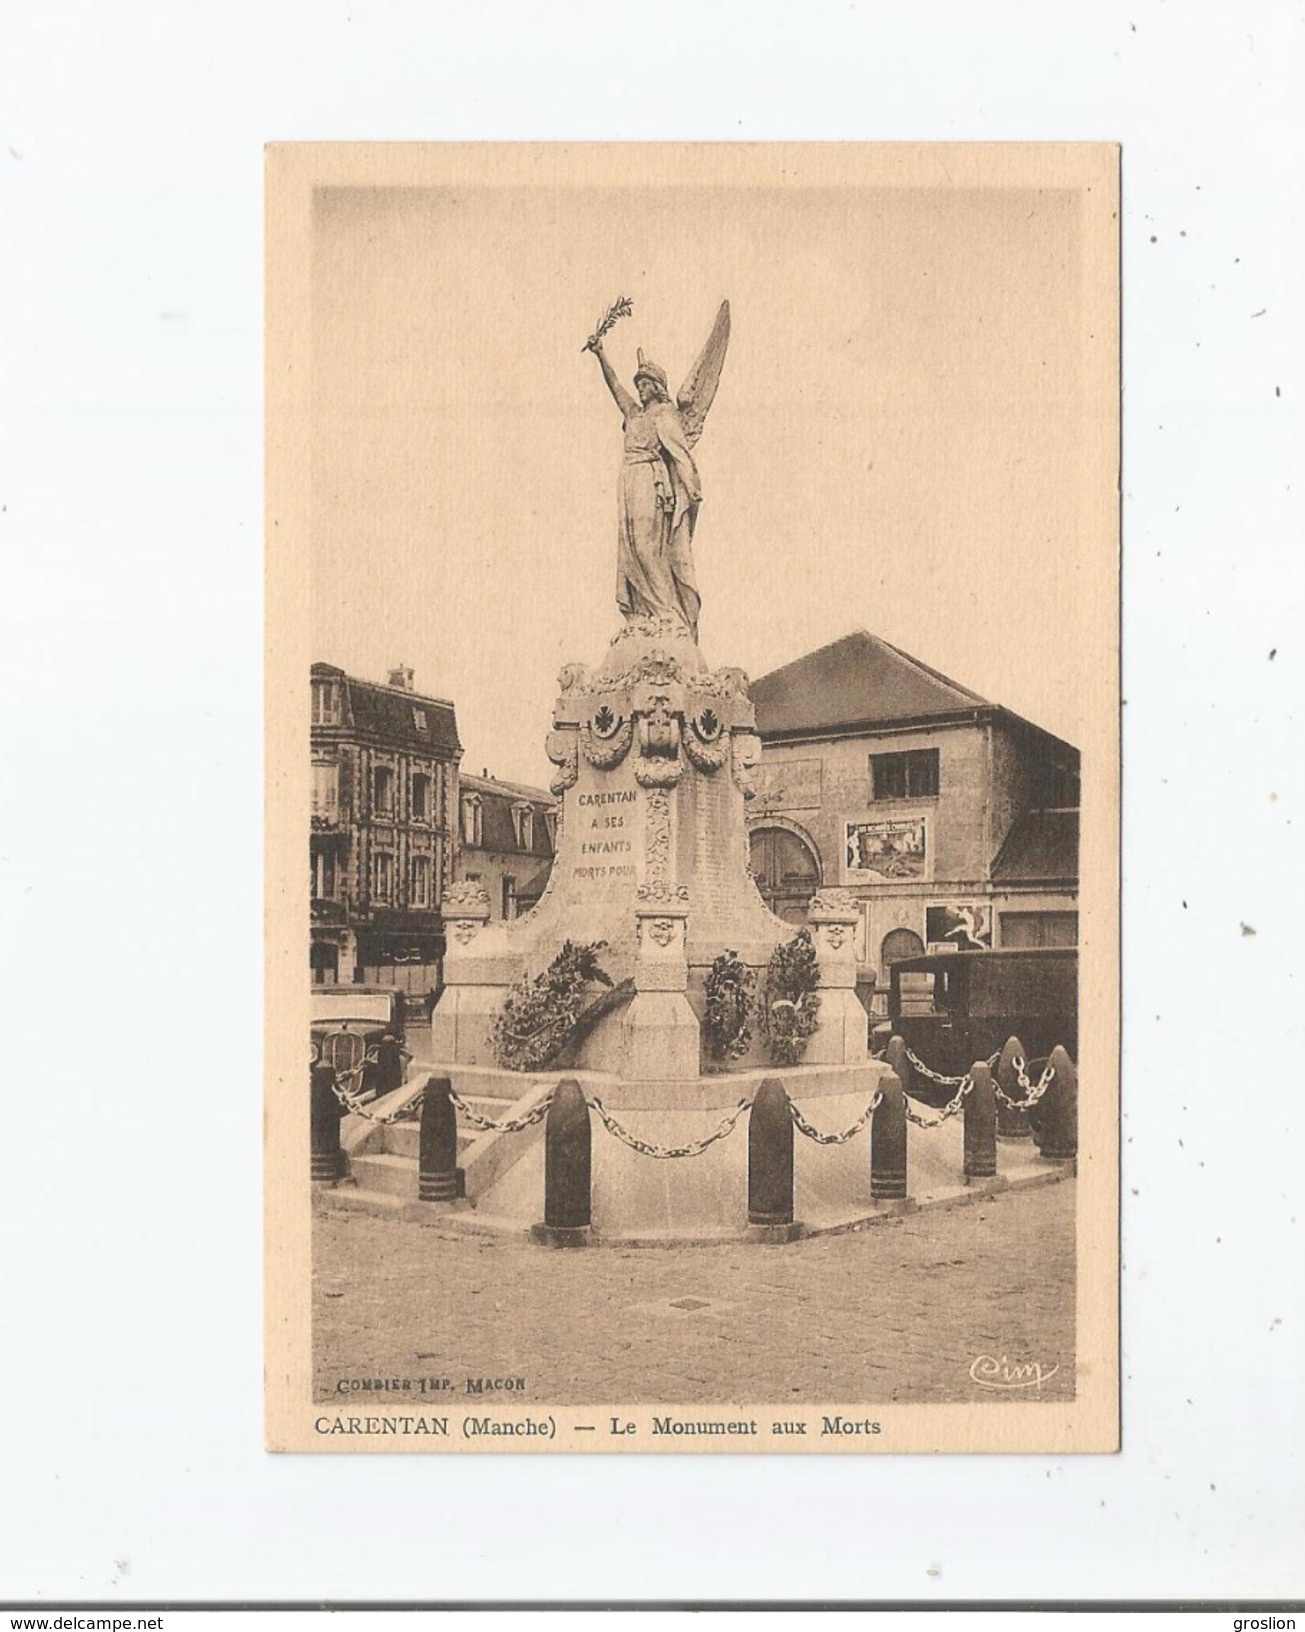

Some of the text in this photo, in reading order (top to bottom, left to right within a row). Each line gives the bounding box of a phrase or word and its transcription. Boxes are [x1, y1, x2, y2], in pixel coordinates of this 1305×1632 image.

[578, 791, 637, 807] CARENTAN
[591, 816, 625, 829] A SES
[581, 841, 632, 854] ENFANTS
[573, 866, 606, 880] MORTS
